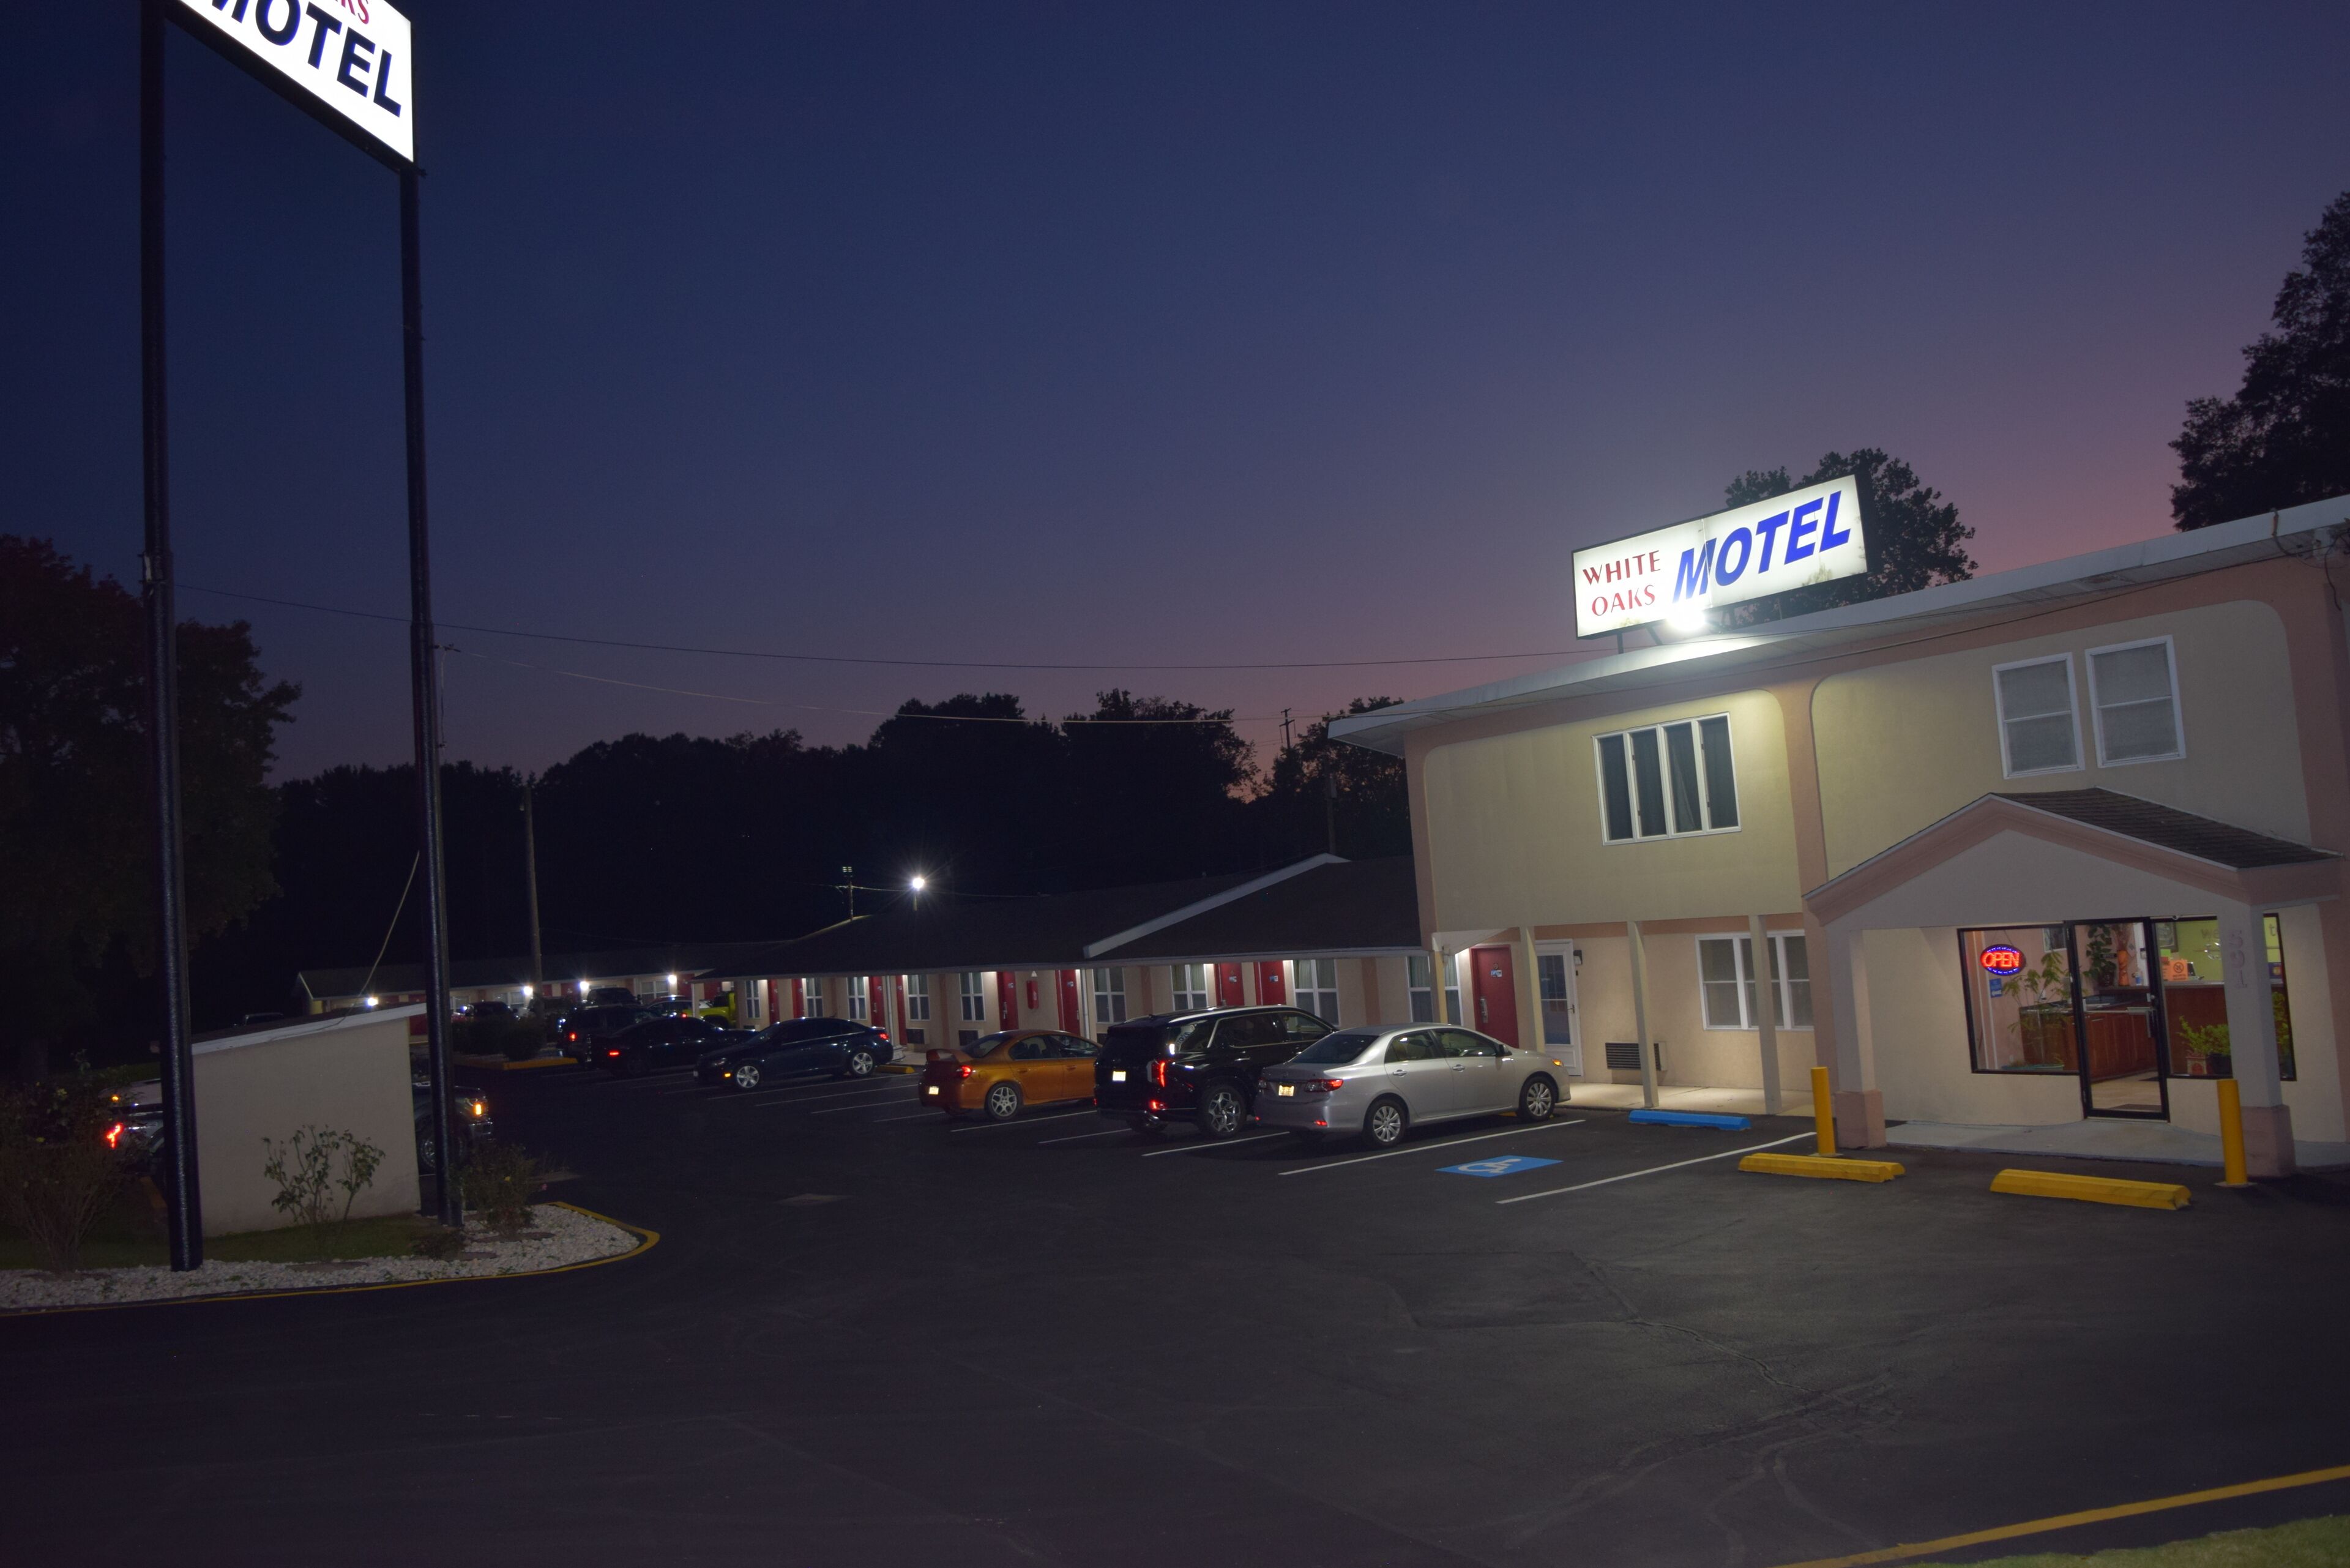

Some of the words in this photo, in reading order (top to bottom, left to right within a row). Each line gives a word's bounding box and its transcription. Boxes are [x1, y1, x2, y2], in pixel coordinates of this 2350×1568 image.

[1672, 490, 1851, 603] MOTEL
[1583, 550, 1661, 586] WHITE
[1592, 584, 1655, 616] OAKS
[1983, 952, 2020, 967] OPEN
